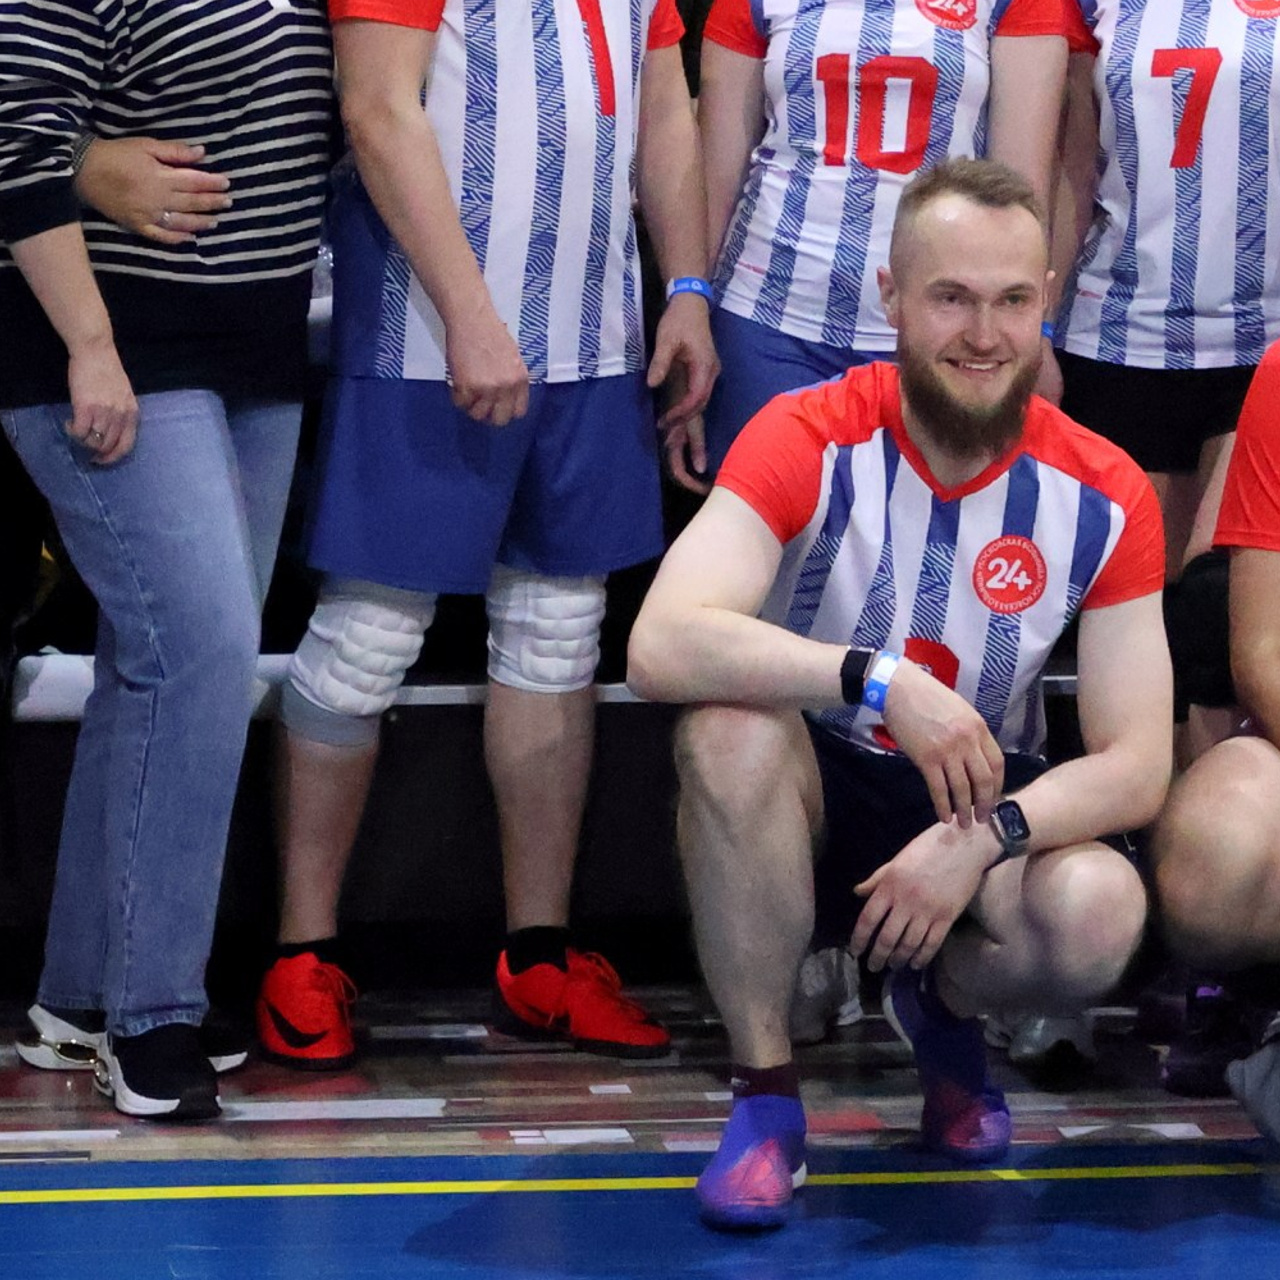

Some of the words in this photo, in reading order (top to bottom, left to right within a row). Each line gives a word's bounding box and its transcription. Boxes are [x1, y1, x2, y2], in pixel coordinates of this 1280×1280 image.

[816, 53, 938, 173] 10
[1150, 47, 1223, 169] 7
[986, 557, 1033, 591] 24
